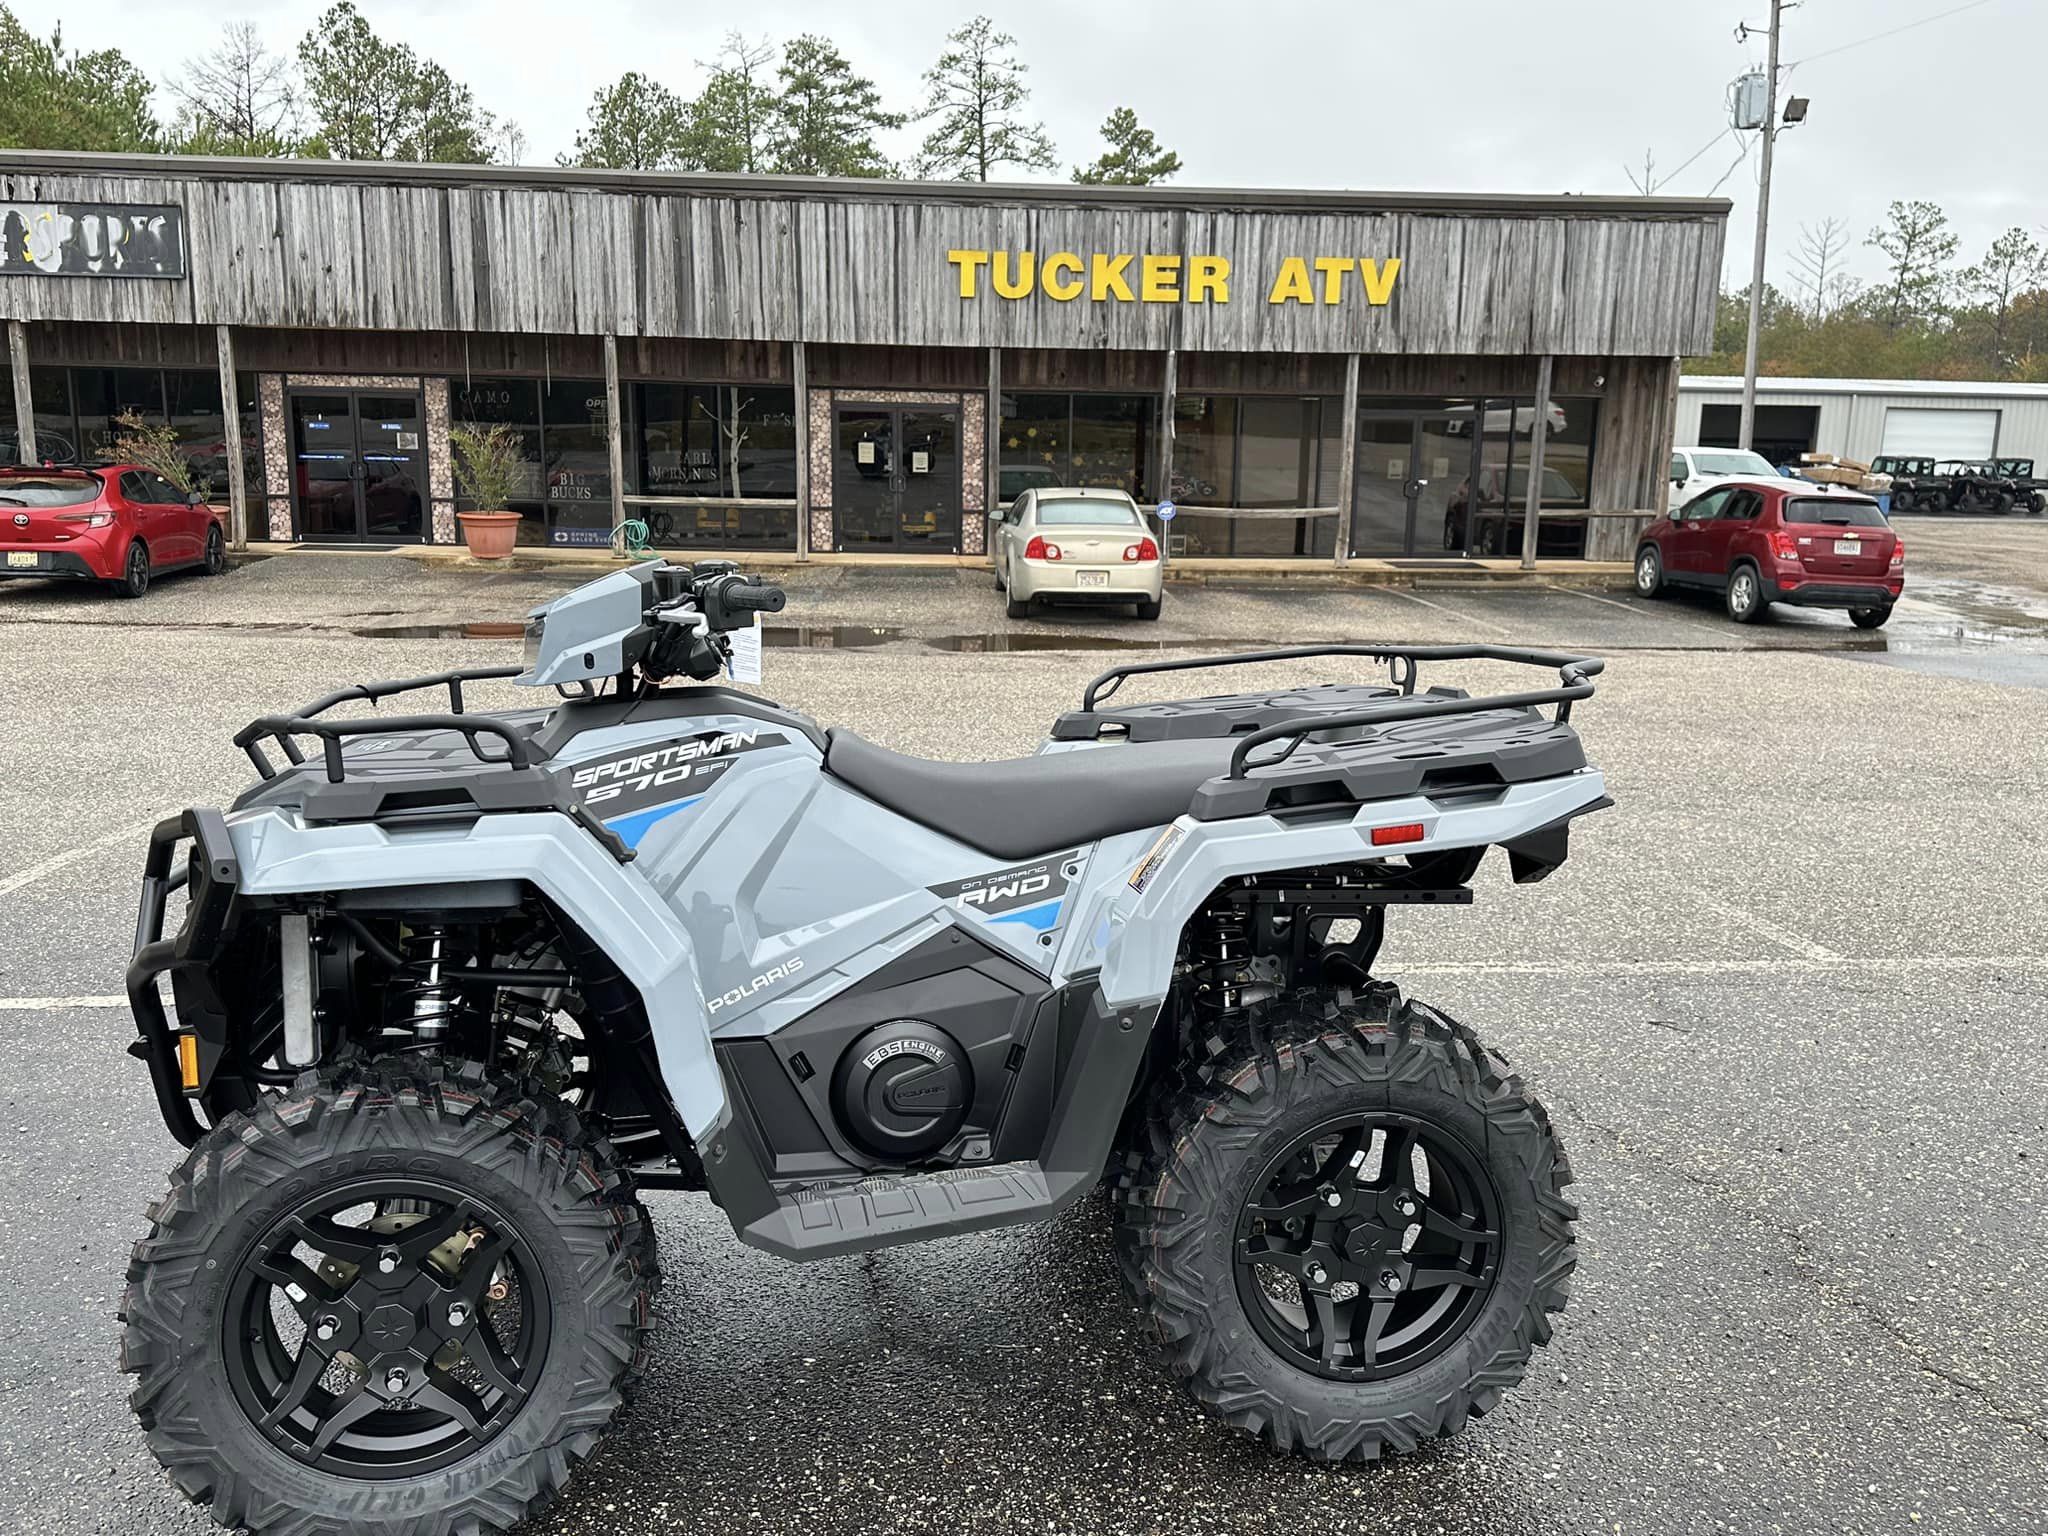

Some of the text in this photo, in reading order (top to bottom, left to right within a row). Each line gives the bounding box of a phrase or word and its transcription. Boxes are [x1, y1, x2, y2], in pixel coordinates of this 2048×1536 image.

[948, 249, 1402, 306] TUCKER ATV
[459, 390, 511, 405] CAMO
[551, 486, 592, 499] BUCKS
[560, 472, 585, 486] BIG
[571, 728, 760, 789] SPORTSMAN
[584, 761, 728, 805] 570 EFI
[956, 874, 1050, 909] AWD
[961, 866, 1048, 890] ON DEMAND
[707, 956, 805, 1015] POLARIS
[866, 1042, 900, 1067] EBS
[903, 1041, 945, 1059] ENGINE
